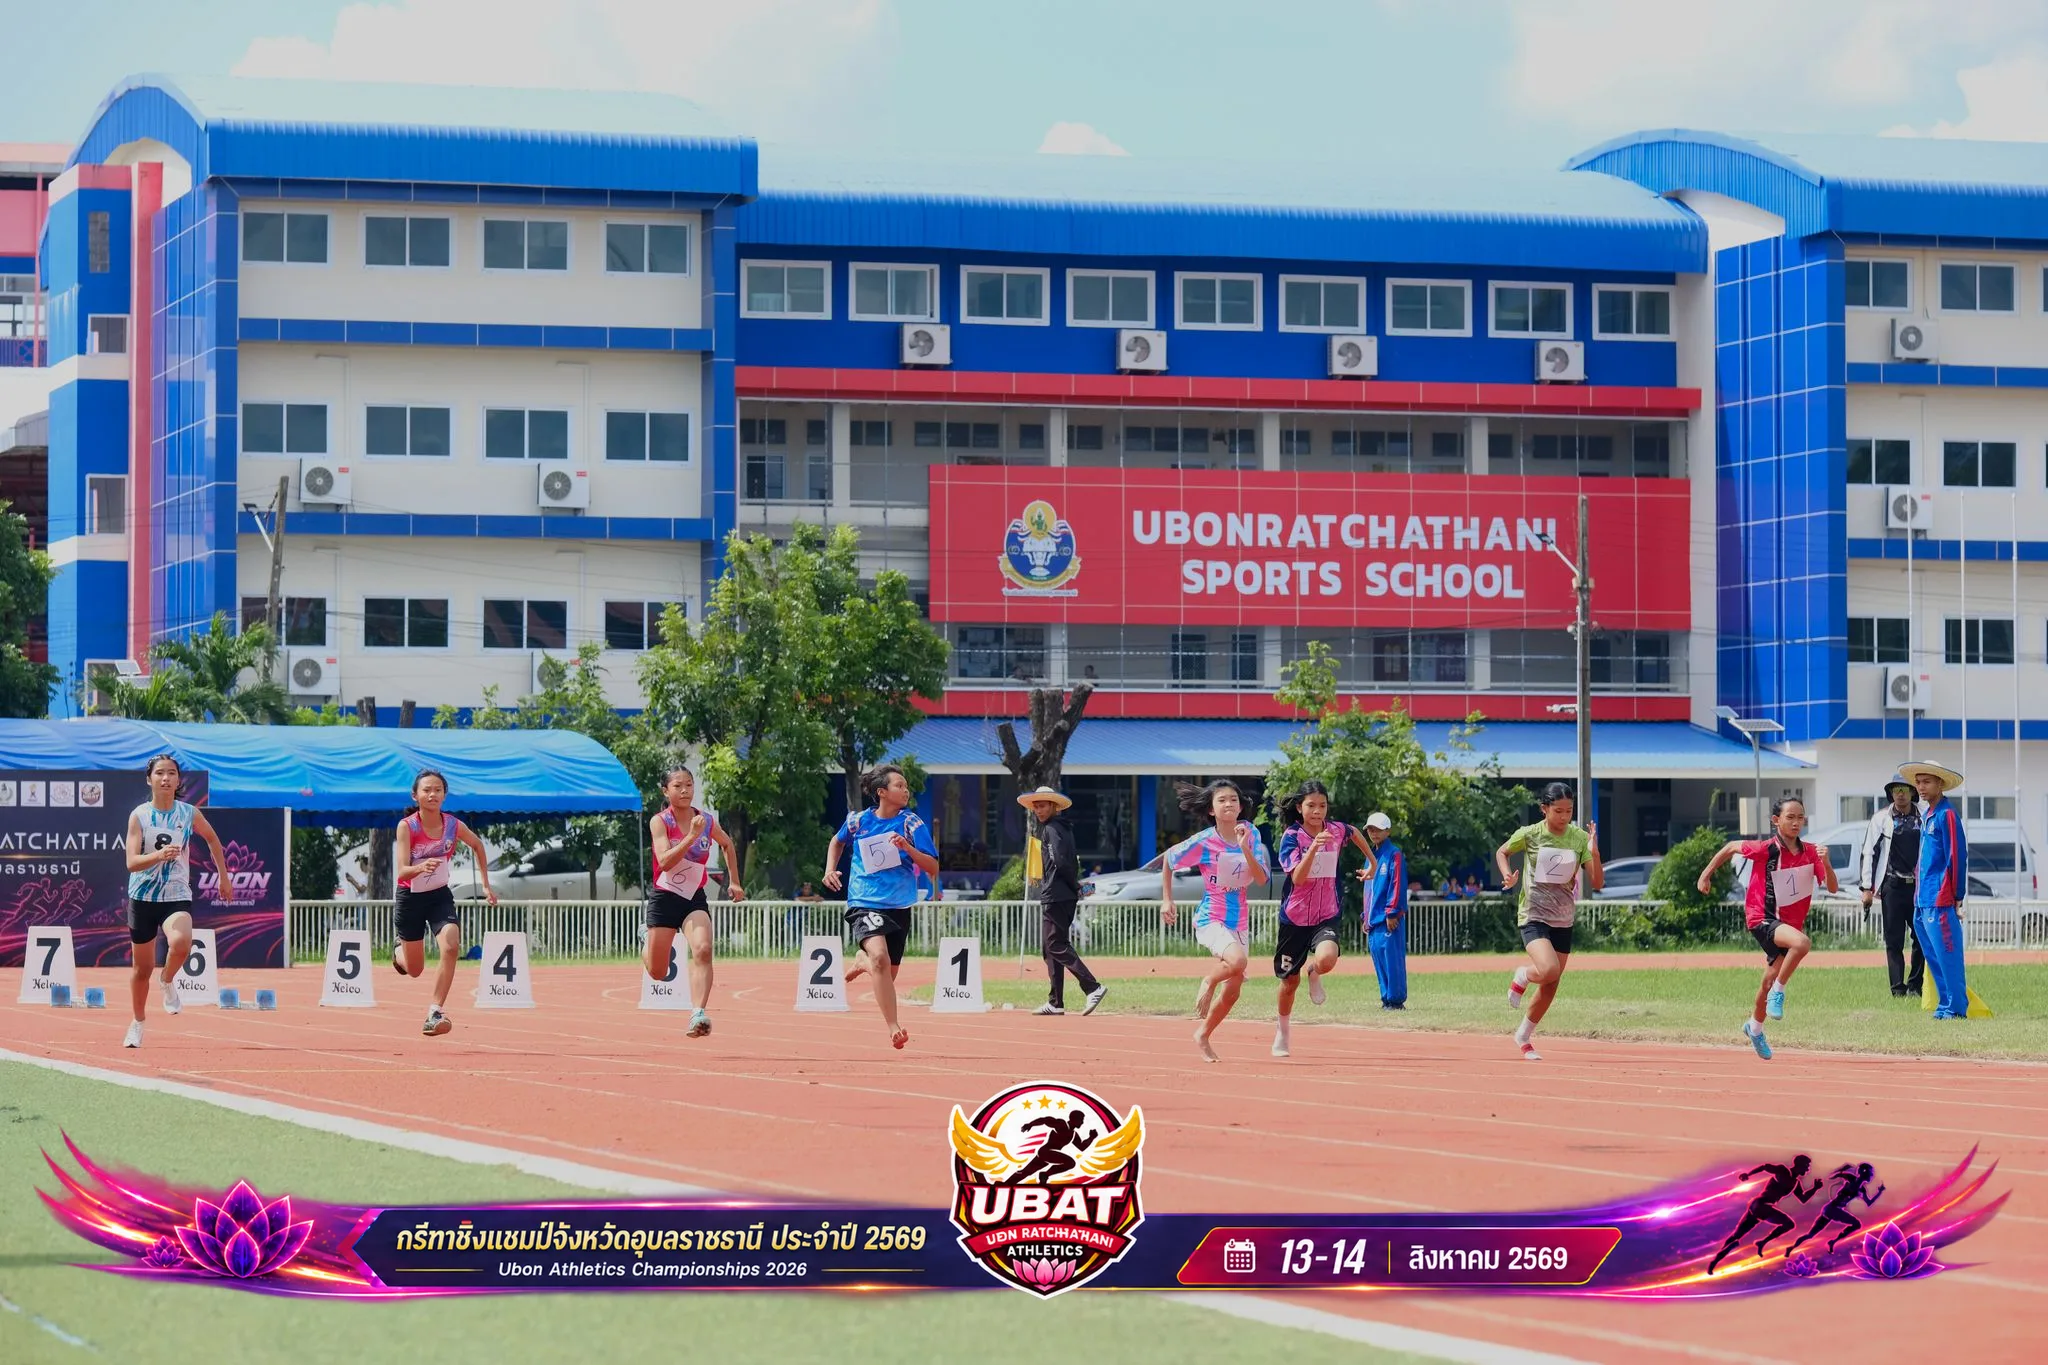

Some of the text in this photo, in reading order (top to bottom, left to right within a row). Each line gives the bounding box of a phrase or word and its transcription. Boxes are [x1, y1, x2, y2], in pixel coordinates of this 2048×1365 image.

[1133, 510, 1556, 552] UBONRATCHATHANI
[1182, 559, 1525, 599] SPORTS SCHOOL
[869, 841, 885, 867] 5
[1545, 854, 1563, 877] 2
[672, 866, 693, 884] 6
[1232, 861, 1245, 880] 4
[1786, 872, 1800, 897] 1
[862, 911, 884, 932] 16
[36, 938, 61, 976] 7
[183, 939, 206, 977] 6
[336, 942, 361, 980] 5
[493, 944, 517, 982] 4
[810, 948, 833, 985] 2
[951, 948, 969, 986] 1
[177, 979, 206, 991] Nelco
[332, 981, 361, 994] Nelco
[489, 984, 517, 996] Nelco
[806, 987, 834, 999] Nelco
[943, 987, 971, 999] Nelco
